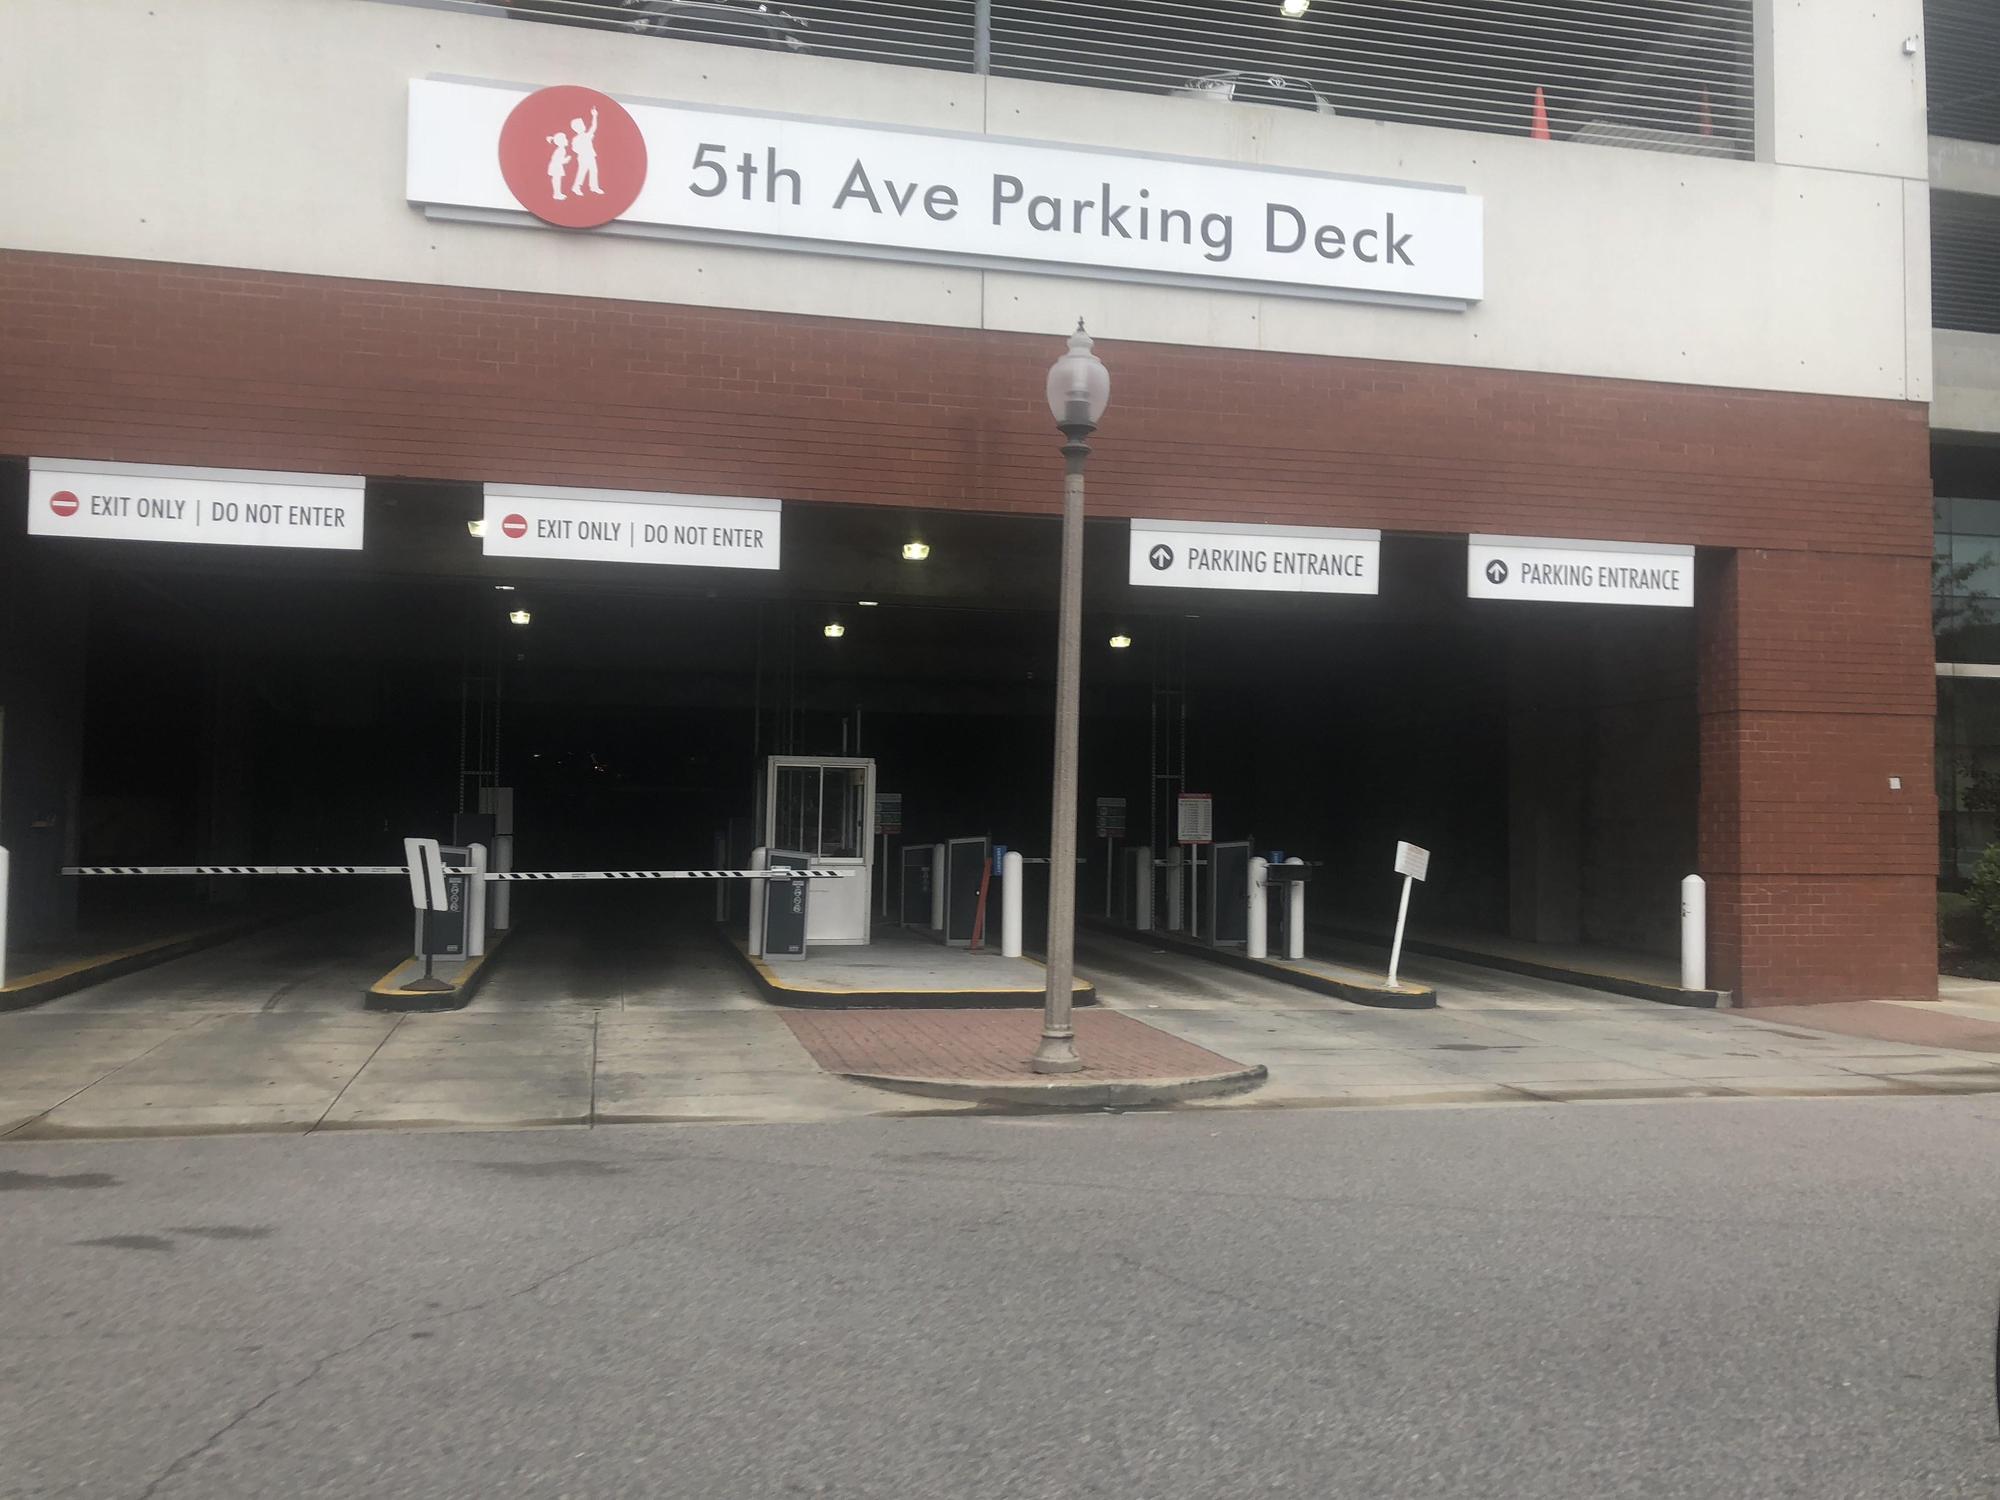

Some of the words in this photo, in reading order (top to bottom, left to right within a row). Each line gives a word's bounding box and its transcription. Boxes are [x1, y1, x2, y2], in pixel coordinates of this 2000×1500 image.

[689, 143, 801, 205] 5th
[832, 158, 959, 221] Ave
[992, 173, 1233, 262] Parking
[1265, 202, 1415, 266] Deck
[90, 495, 130, 517] EXIT
[136, 498, 186, 519] ONLY
[211, 501, 239, 522] DO
[245, 503, 283, 525] NOT
[288, 506, 346, 527] ENTER
[537, 518, 573, 539] EXIT
[577, 520, 621, 541] ONLY
[644, 524, 669, 543] DO
[674, 526, 708, 545] NOT
[713, 528, 764, 548] ENTER
[1187, 547, 1267, 573] PARKING
[1273, 552, 1365, 577] ENTRANCE
[1520, 562, 1593, 586] PARKING
[1599, 566, 1680, 590] ENTRANCE
